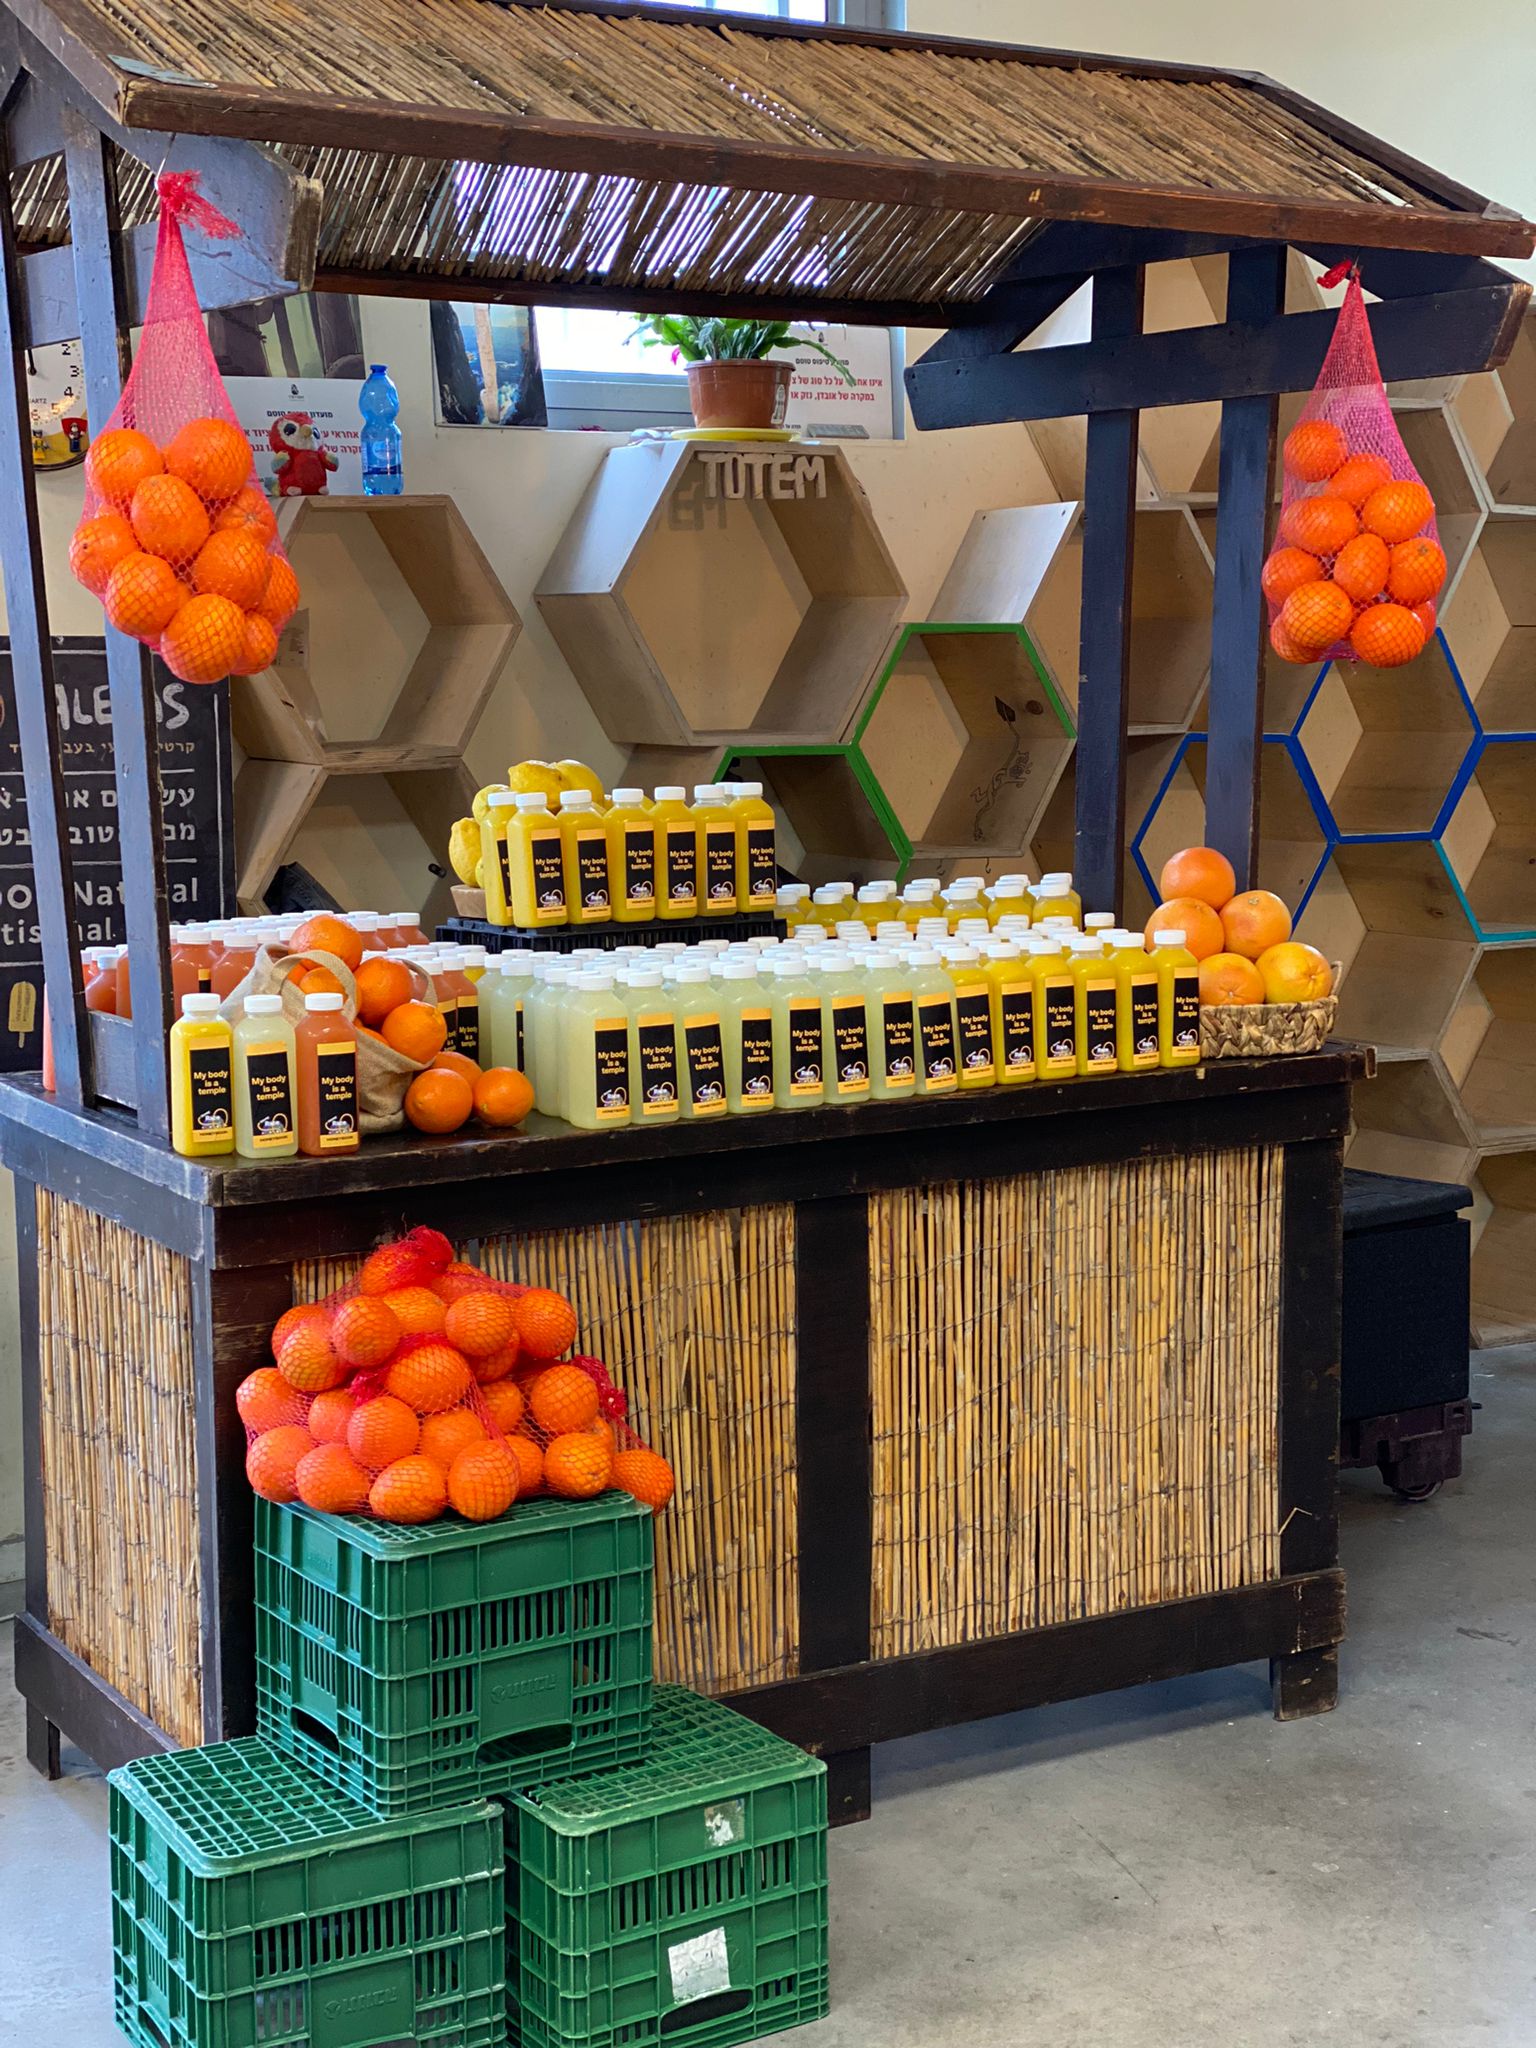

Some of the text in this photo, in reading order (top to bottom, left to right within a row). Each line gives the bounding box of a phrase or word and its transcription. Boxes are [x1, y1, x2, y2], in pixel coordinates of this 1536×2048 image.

[70, 365, 80, 377] 3
[869, 378, 883, 387] אינו
[63, 386, 75, 397] 4
[837, 391, 849, 401] של
[850, 392, 875, 402] במקרה
[697, 452, 827, 500] TOTEM
[628, 850, 638, 858] My
[74, 877, 198, 907] Natal
[1134, 1004, 1144, 1012] My
[886, 1023, 896, 1031] My
[923, 1023, 950, 1034] My body
[792, 1029, 820, 1038] My body
[965, 1029, 987, 1037] temple
[744, 1040, 771, 1049] My body
[841, 1041, 863, 1050] temple
[928, 1038, 950, 1047] temple
[643, 1046, 673, 1056] My body
[690, 1046, 719, 1056] My body
[796, 1044, 819, 1052] temple
[598, 1050, 627, 1060] My body
[747, 1055, 769, 1063] temple
[647, 1061, 672, 1069] temple
[695, 1061, 719, 1070] temple
[601, 1066, 625, 1074] temple
[194, 1070, 228, 1080] My body
[252, 1075, 286, 1086] My body
[322, 1076, 354, 1086] My body
[198, 1087, 226, 1095] temple
[256, 1092, 285, 1100] temple
[325, 1092, 352, 1100] temple
